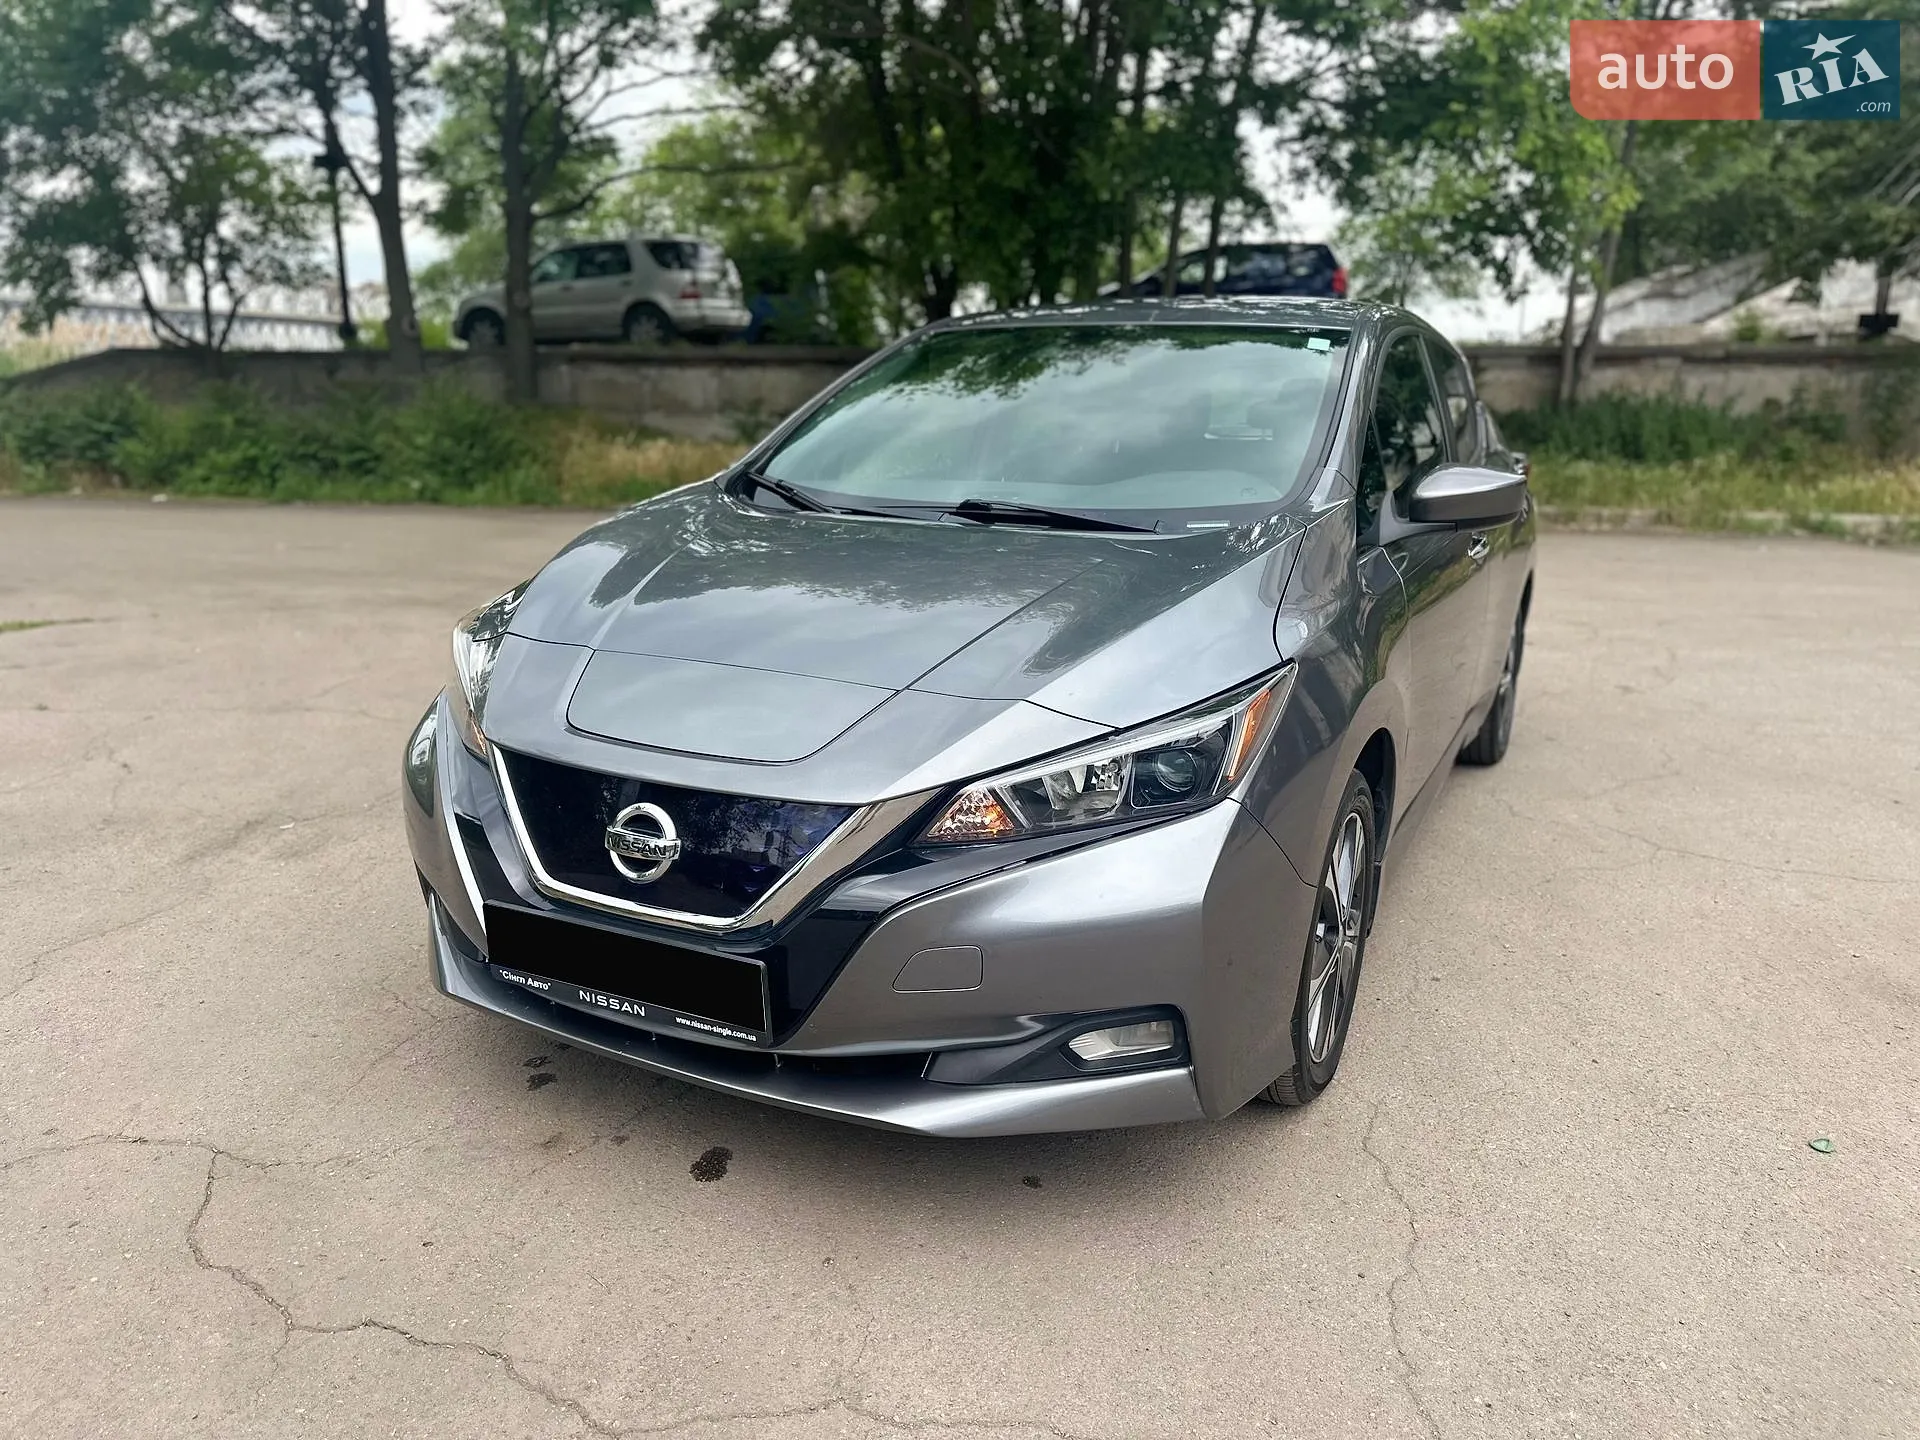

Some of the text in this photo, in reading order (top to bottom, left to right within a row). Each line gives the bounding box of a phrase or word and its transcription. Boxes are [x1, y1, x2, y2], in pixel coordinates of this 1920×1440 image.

[606, 835, 667, 858] NISSAN
[579, 989, 646, 1017] NISSAN
[675, 1016, 757, 1042] www.nissan-single.com.ua
